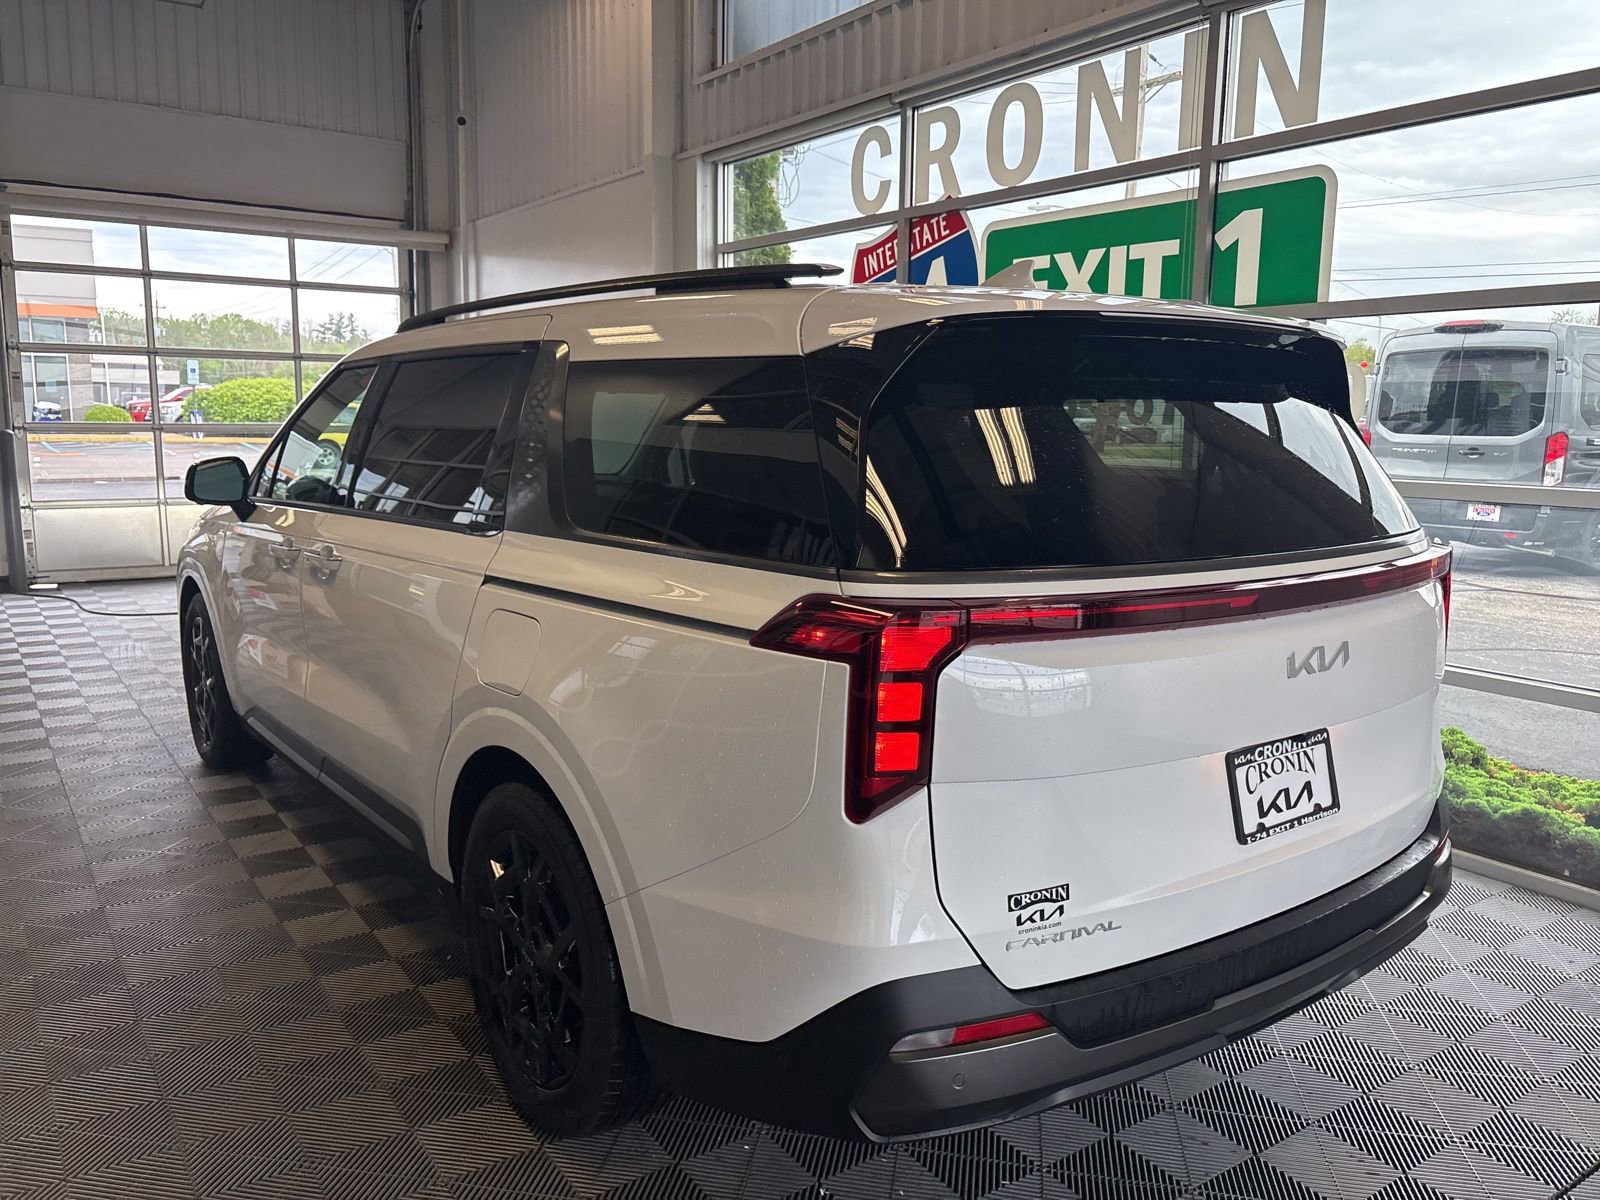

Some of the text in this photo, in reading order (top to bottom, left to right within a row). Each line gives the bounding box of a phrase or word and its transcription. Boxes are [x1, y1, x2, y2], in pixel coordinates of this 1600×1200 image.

[851, 0, 1326, 216] CRONIN
[863, 213, 950, 278] INTETATE
[1214, 208, 1264, 306] 1
[1285, 640, 1350, 679] KIA
[1245, 748, 1317, 795] CRONIN
[1256, 780, 1314, 820] KIA
[1246, 807, 1339, 844] I-74 EXIT 1 Harrison
[1009, 885, 1068, 911] CRONIN
[1016, 904, 1065, 927] KIA
[1005, 920, 1123, 952] CARNIVAL
[1018, 921, 1062, 935] croninkia.com
